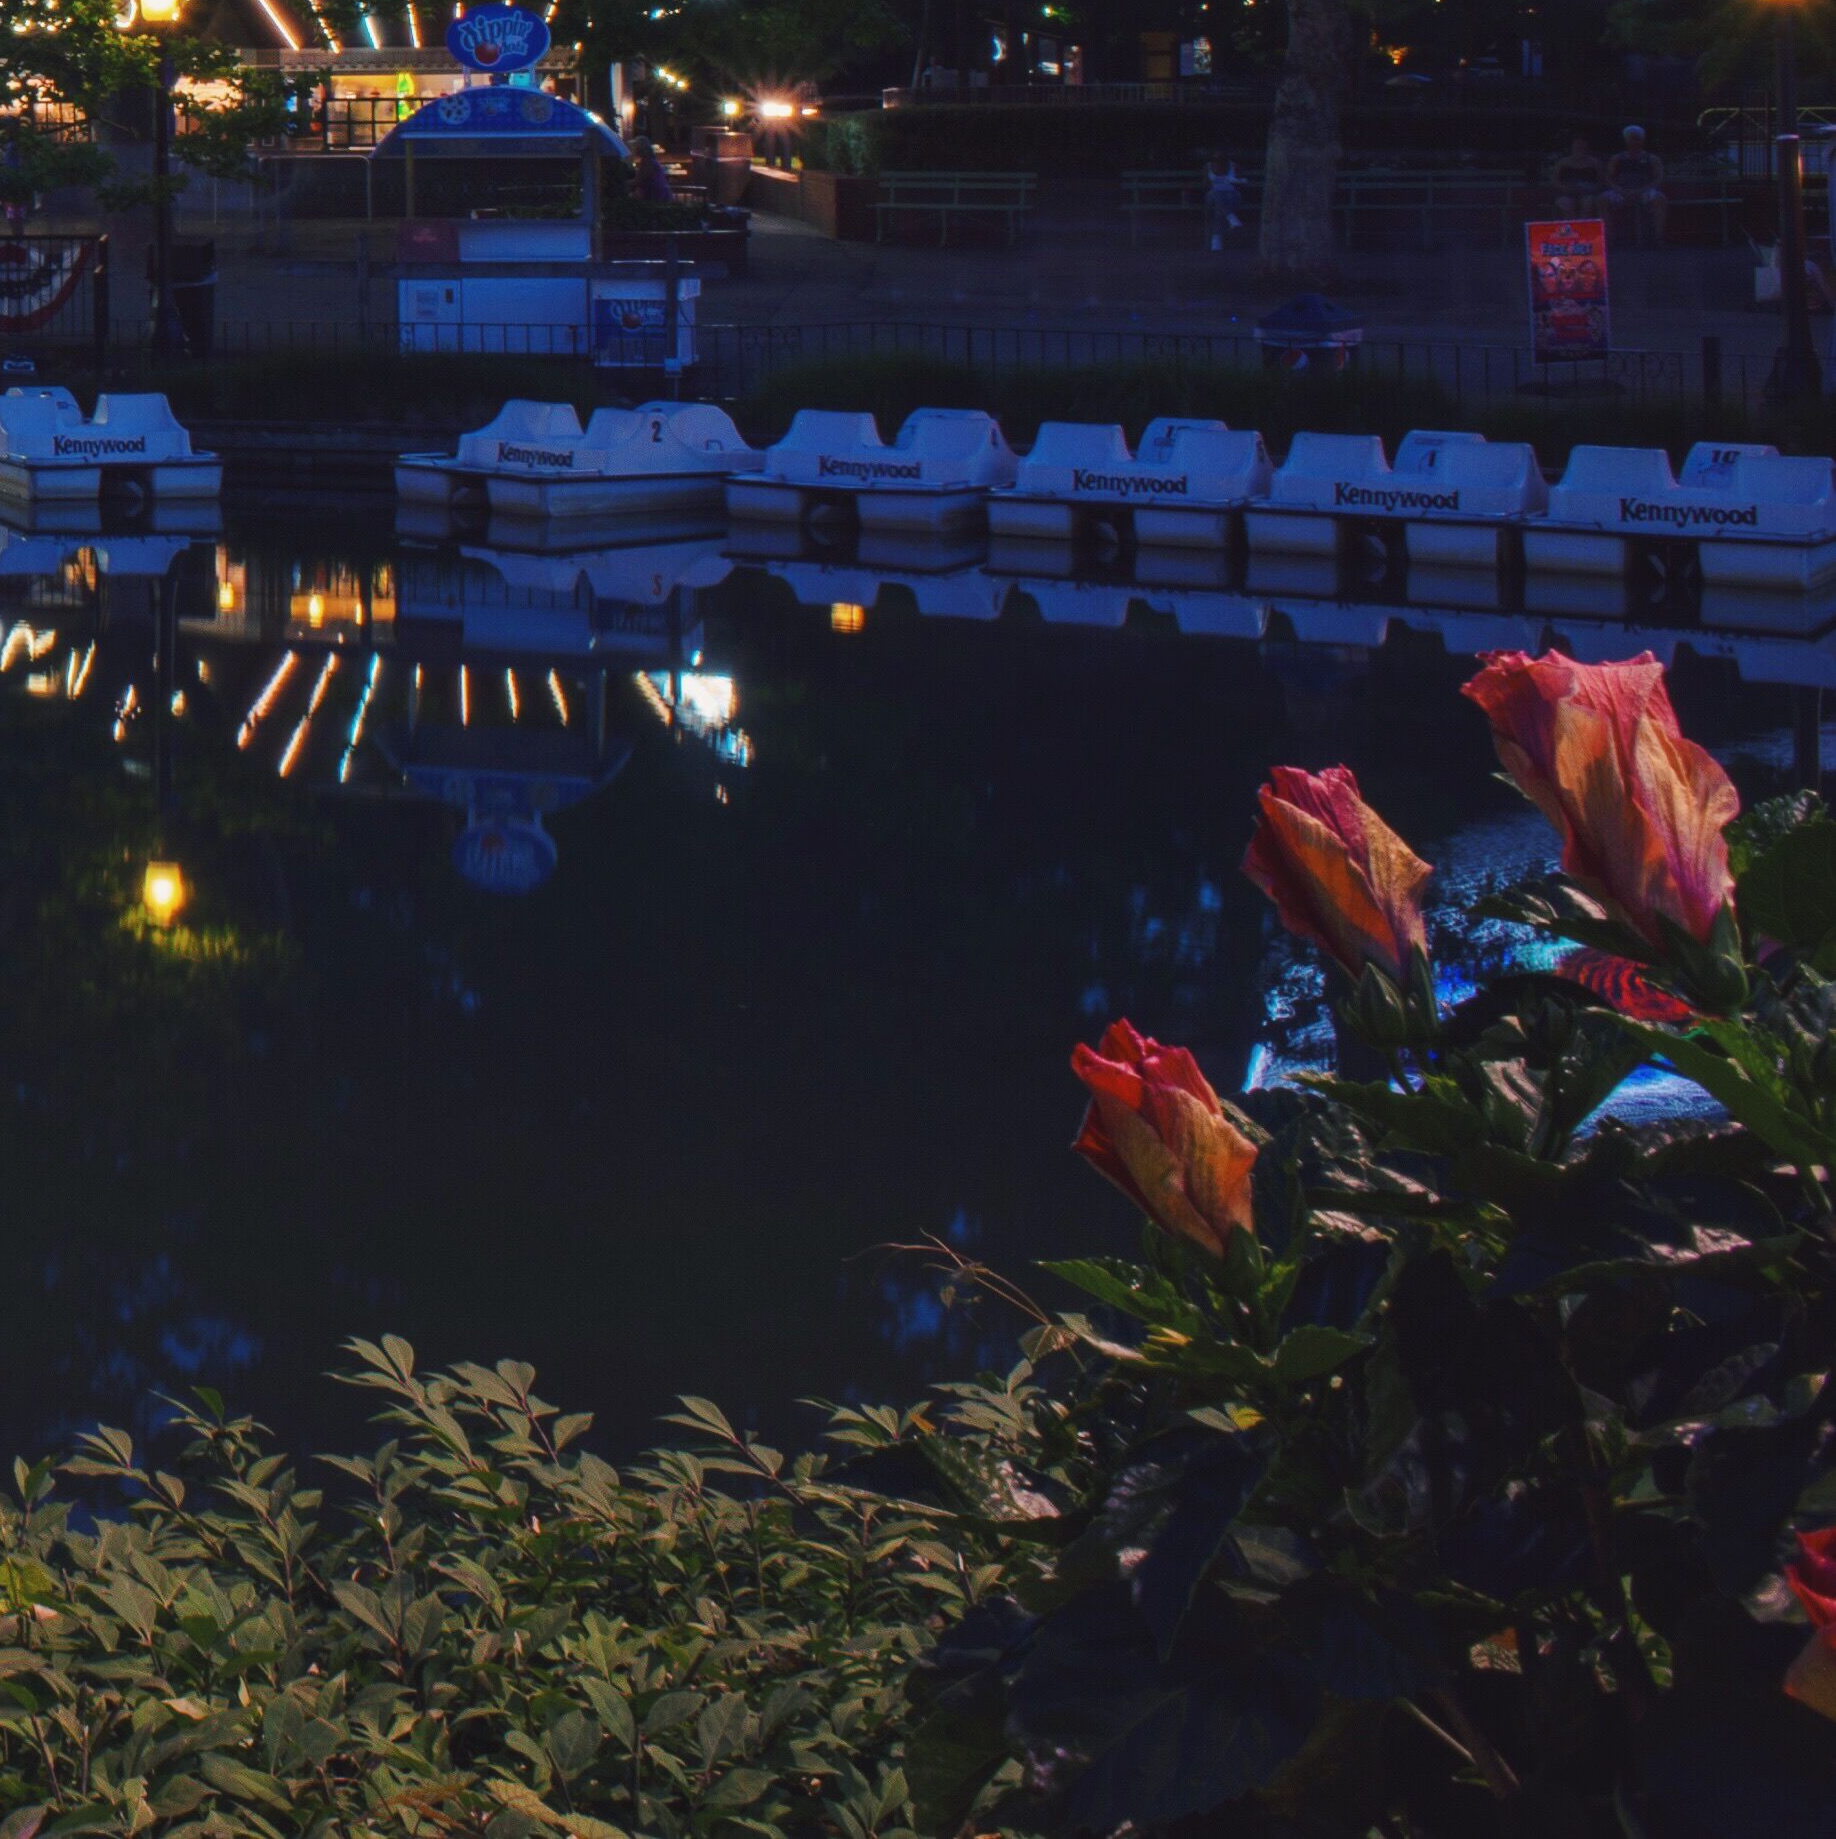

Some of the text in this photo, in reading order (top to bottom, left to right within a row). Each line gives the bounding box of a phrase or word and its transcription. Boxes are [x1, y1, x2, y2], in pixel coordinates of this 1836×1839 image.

[651, 420, 662, 442] 2
[53, 435, 145, 456] Kennywood
[497, 441, 573, 468] Kennywood
[818, 455, 920, 481] Kennywood
[1072, 469, 1187, 495] Kennywood
[1335, 482, 1459, 510] Kennywood
[1620, 497, 1757, 527] Kennywood
